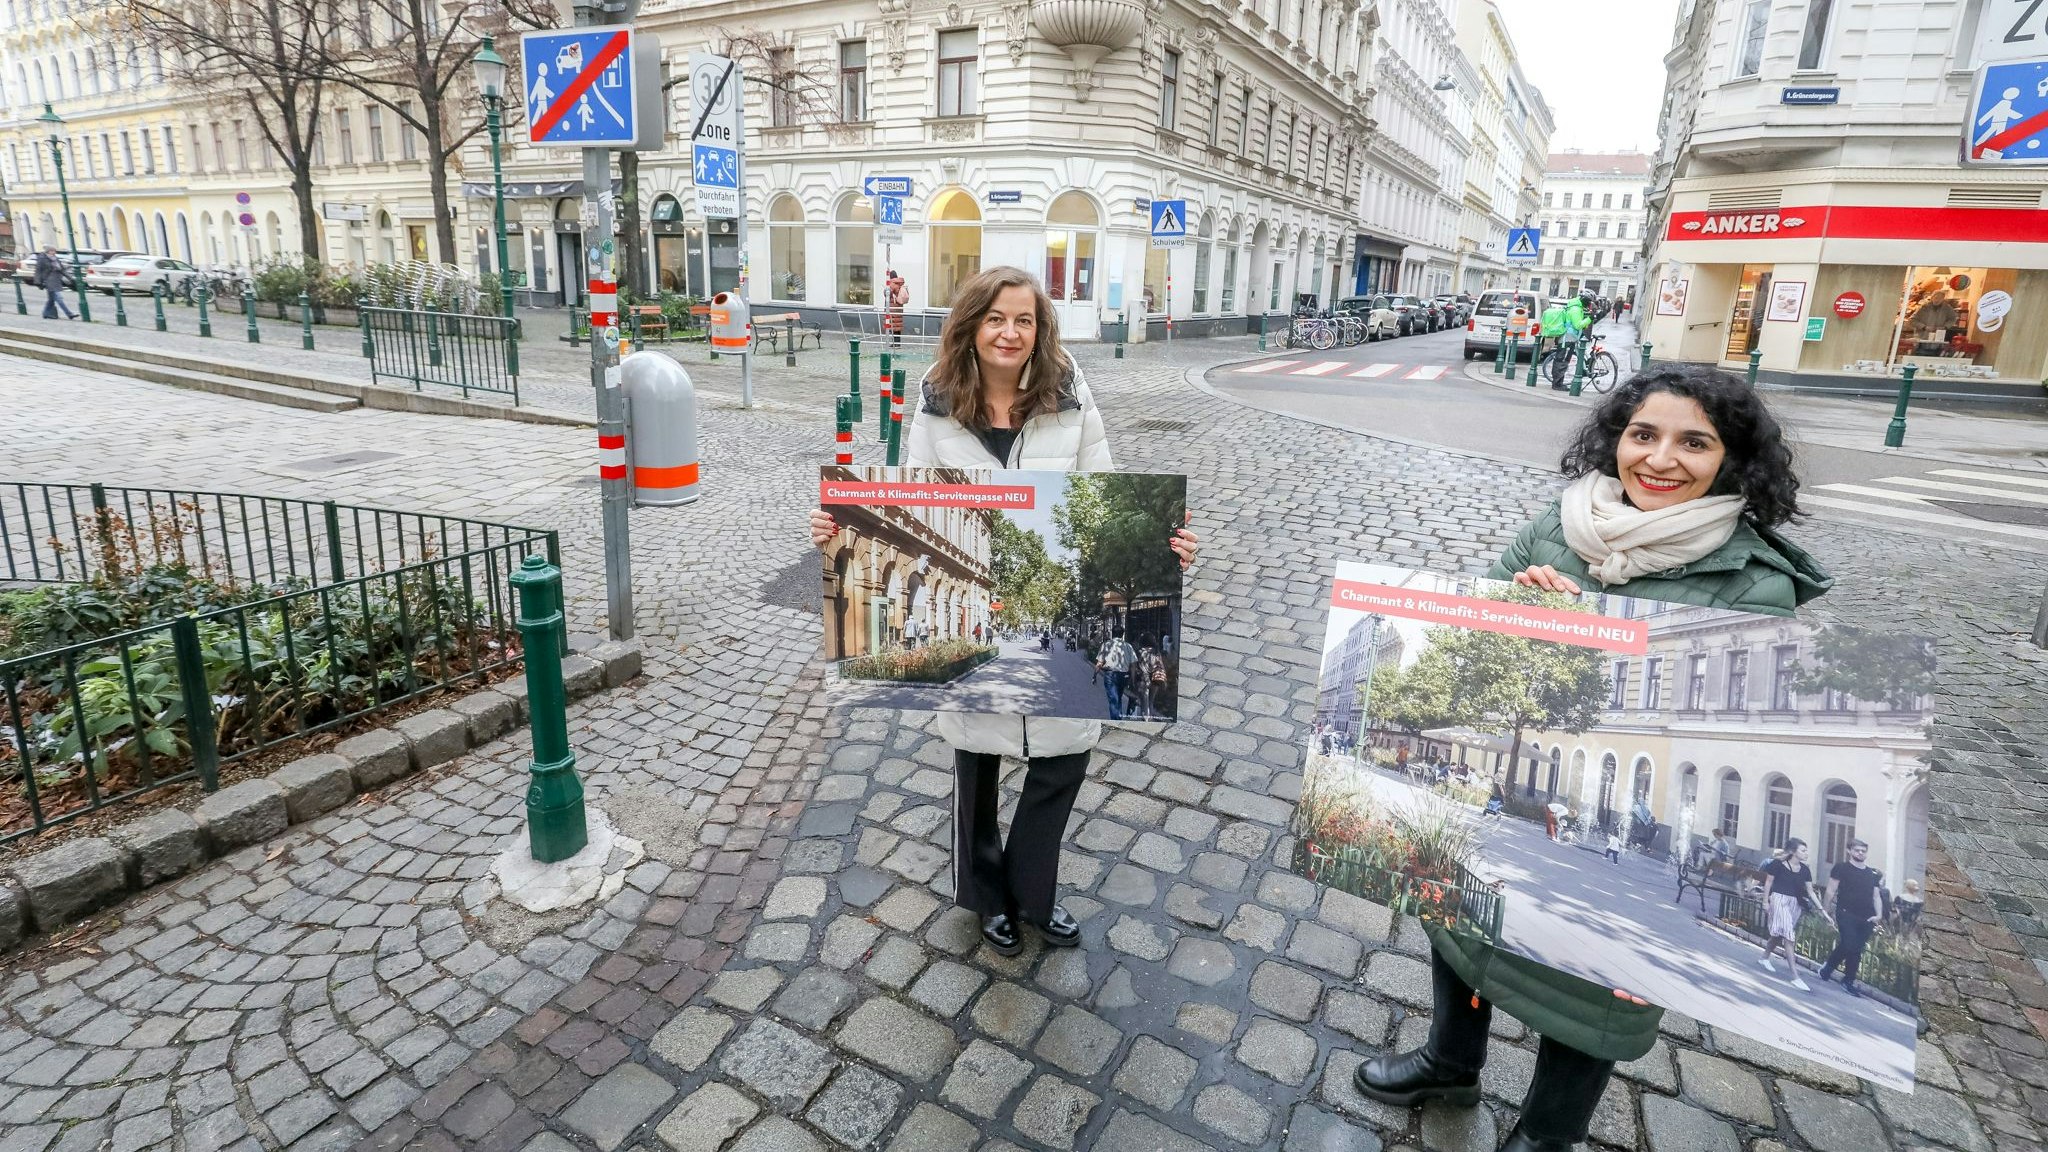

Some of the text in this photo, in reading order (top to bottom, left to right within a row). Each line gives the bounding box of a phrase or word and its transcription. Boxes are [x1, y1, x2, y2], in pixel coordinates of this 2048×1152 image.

[701, 72, 725, 106] 30
[879, 182, 905, 191] EINBAHN
[698, 189, 735, 202] Durchfahrt
[703, 205, 733, 215] verboten
[1701, 214, 1780, 234] ANKER
[1152, 239, 1185, 247] Schulweg
[827, 487, 1028, 503] Charmant & Klimafit: Servitengasse NEU
[1341, 588, 1635, 643] Charmant & Klimafit: Servitenviertel NEU
